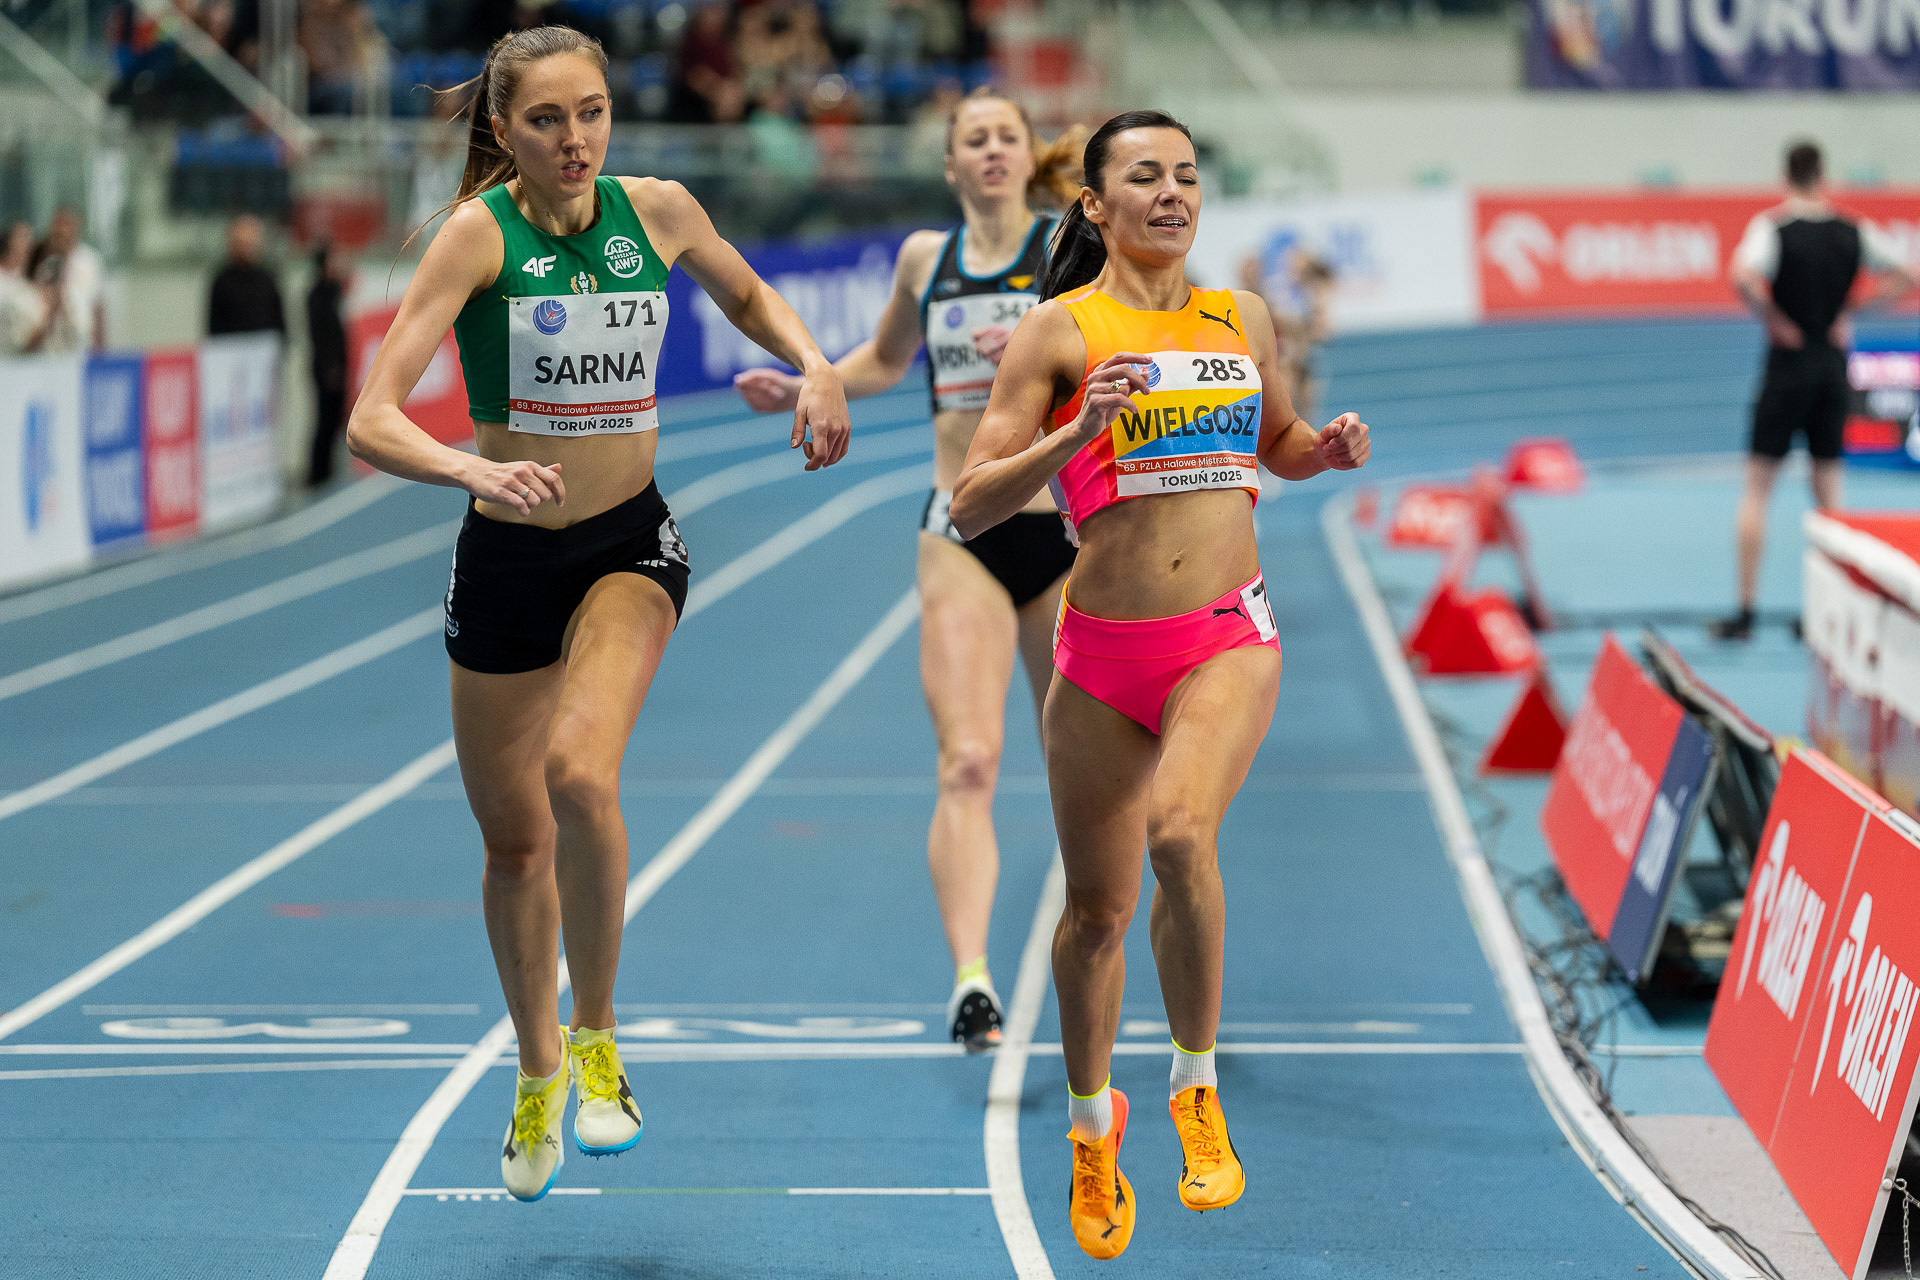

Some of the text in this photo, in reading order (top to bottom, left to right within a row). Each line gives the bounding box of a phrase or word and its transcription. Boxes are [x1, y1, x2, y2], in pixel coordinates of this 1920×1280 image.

[609, 241, 631, 255] AZS
[609, 250, 637, 261] WARSZAWA
[614, 257, 639, 272] AWF
[603, 299, 657, 328] 171
[991, 301, 1033, 322] 34
[534, 351, 646, 385] SARNA
[1191, 358, 1247, 382] 285
[516, 400, 530, 410] 69.
[532, 403, 553, 413] PZLA
[554, 403, 588, 415] Halowe
[589, 402, 640, 413] Mistrzostwa
[548, 417, 634, 432] TORUŃ 2025
[1119, 404, 1257, 442] WIELGOSZ
[1123, 461, 1138, 472] 69.
[1140, 460, 1161, 471] PZLA
[1163, 458, 1196, 469] Halowe
[1158, 469, 1243, 488] TORUŃ 2025
[1756, 864, 1827, 1022] ORLEN
[1837, 943, 1920, 1123] ORLEN
